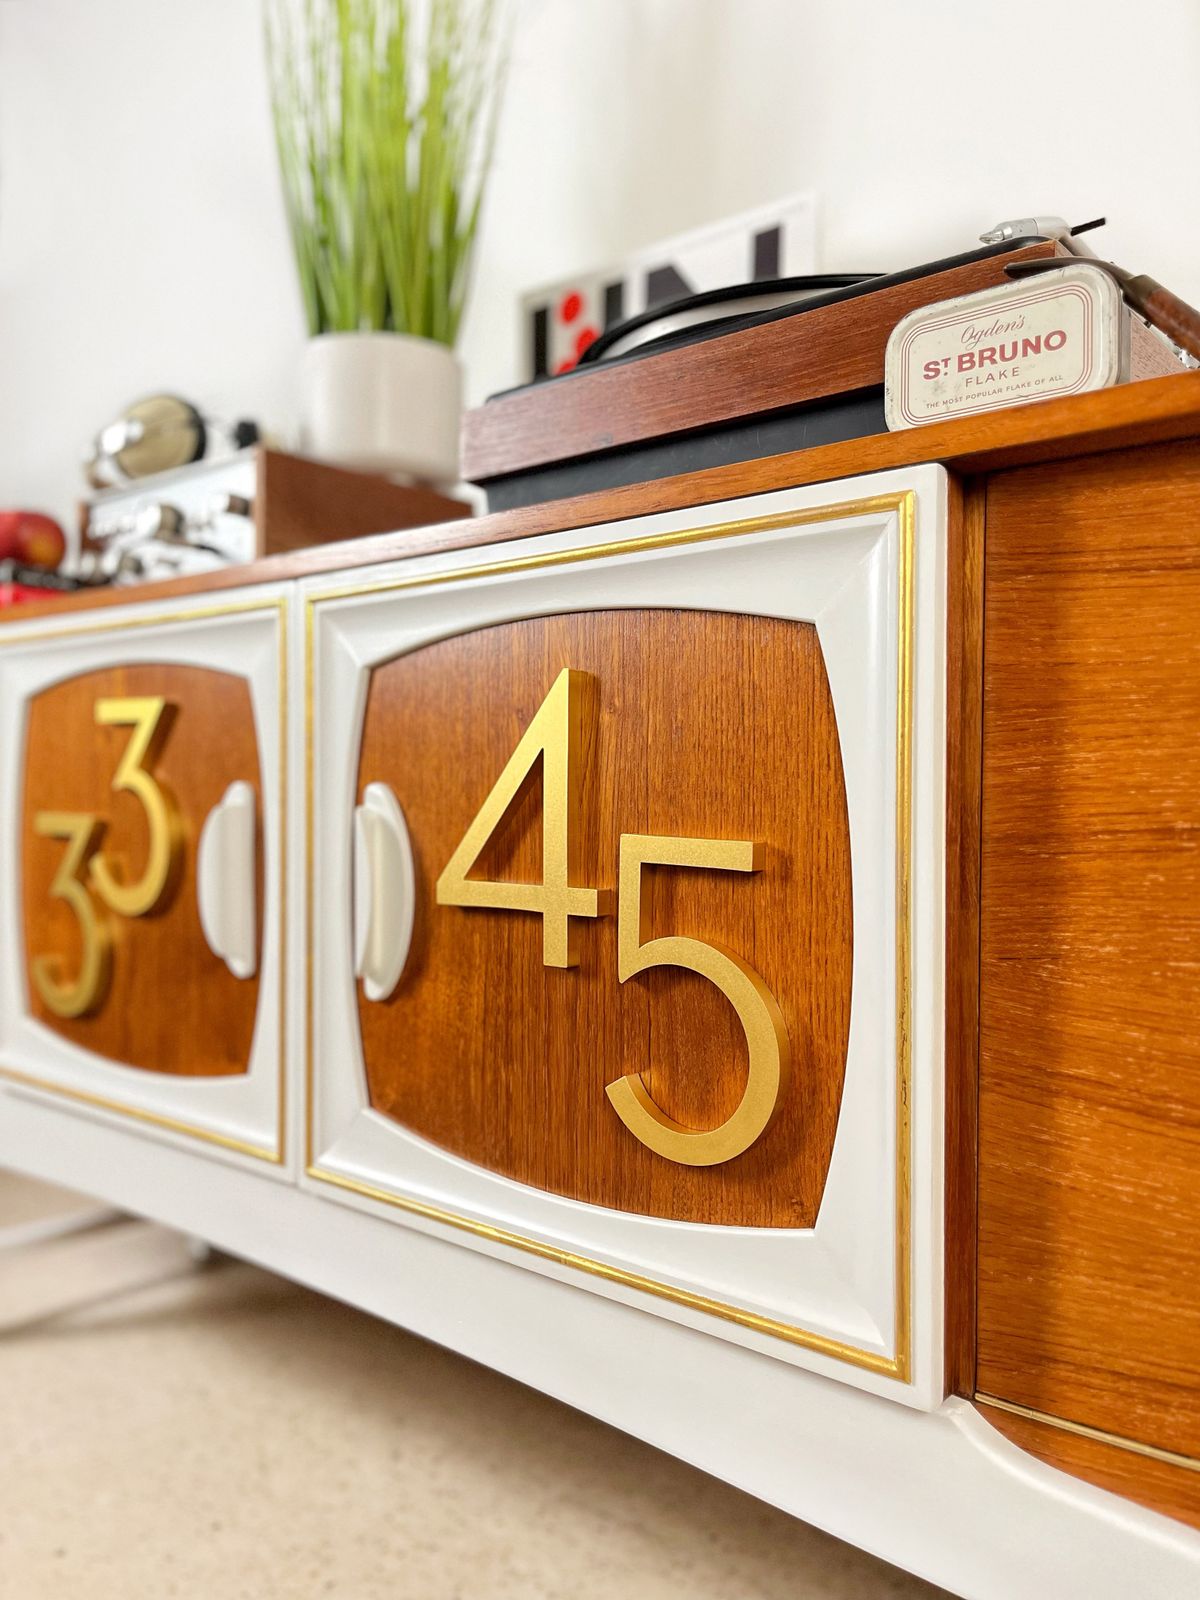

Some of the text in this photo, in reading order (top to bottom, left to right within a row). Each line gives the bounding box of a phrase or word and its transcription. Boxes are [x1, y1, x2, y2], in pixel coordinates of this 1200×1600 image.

[961, 315, 1025, 351] Ogden's
[957, 330, 1067, 373] BRUNO
[942, 396, 963, 405] MOST
[965, 387, 1002, 400] POPULAR
[1006, 381, 1031, 392] FLAKE
[1034, 378, 1045, 386] OF
[1049, 375, 1063, 383] ALL
[965, 366, 1020, 388] FLAKE
